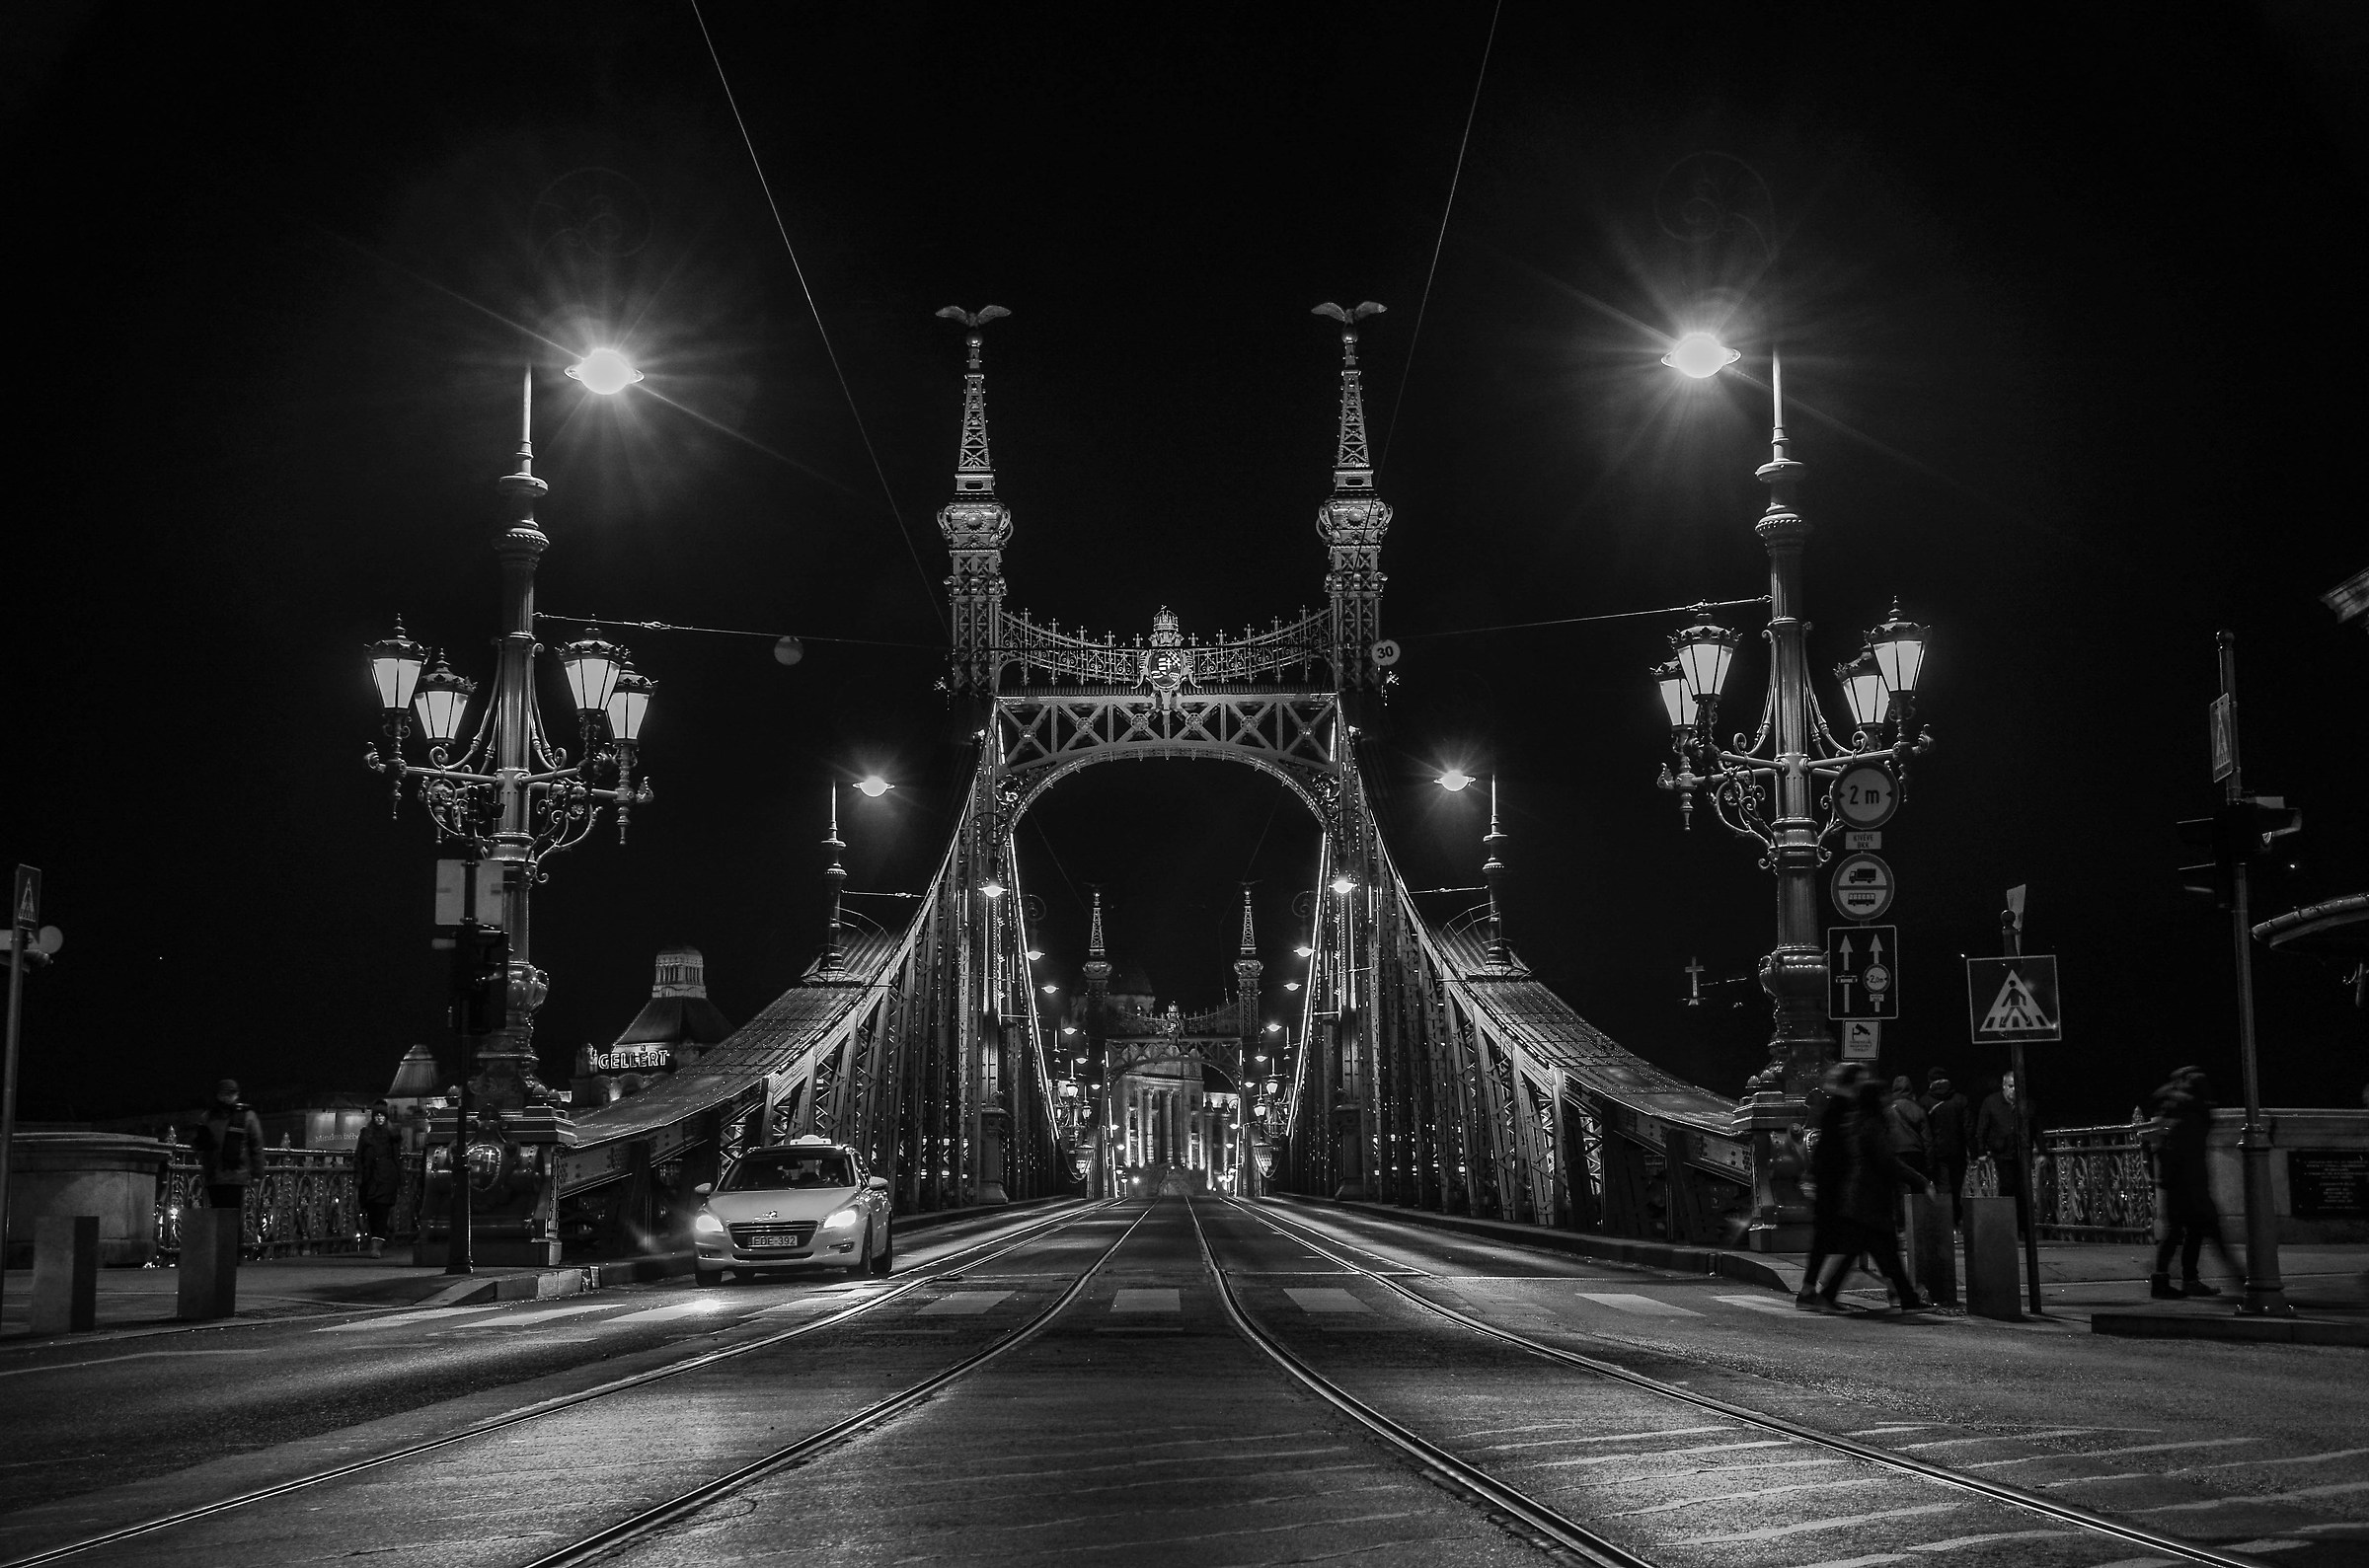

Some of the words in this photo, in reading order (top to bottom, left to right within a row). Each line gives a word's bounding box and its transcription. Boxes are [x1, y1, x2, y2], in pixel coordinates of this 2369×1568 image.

[1377, 646, 1393, 658] 30
[1850, 784, 1858, 804] 2
[1866, 790, 1879, 804] m
